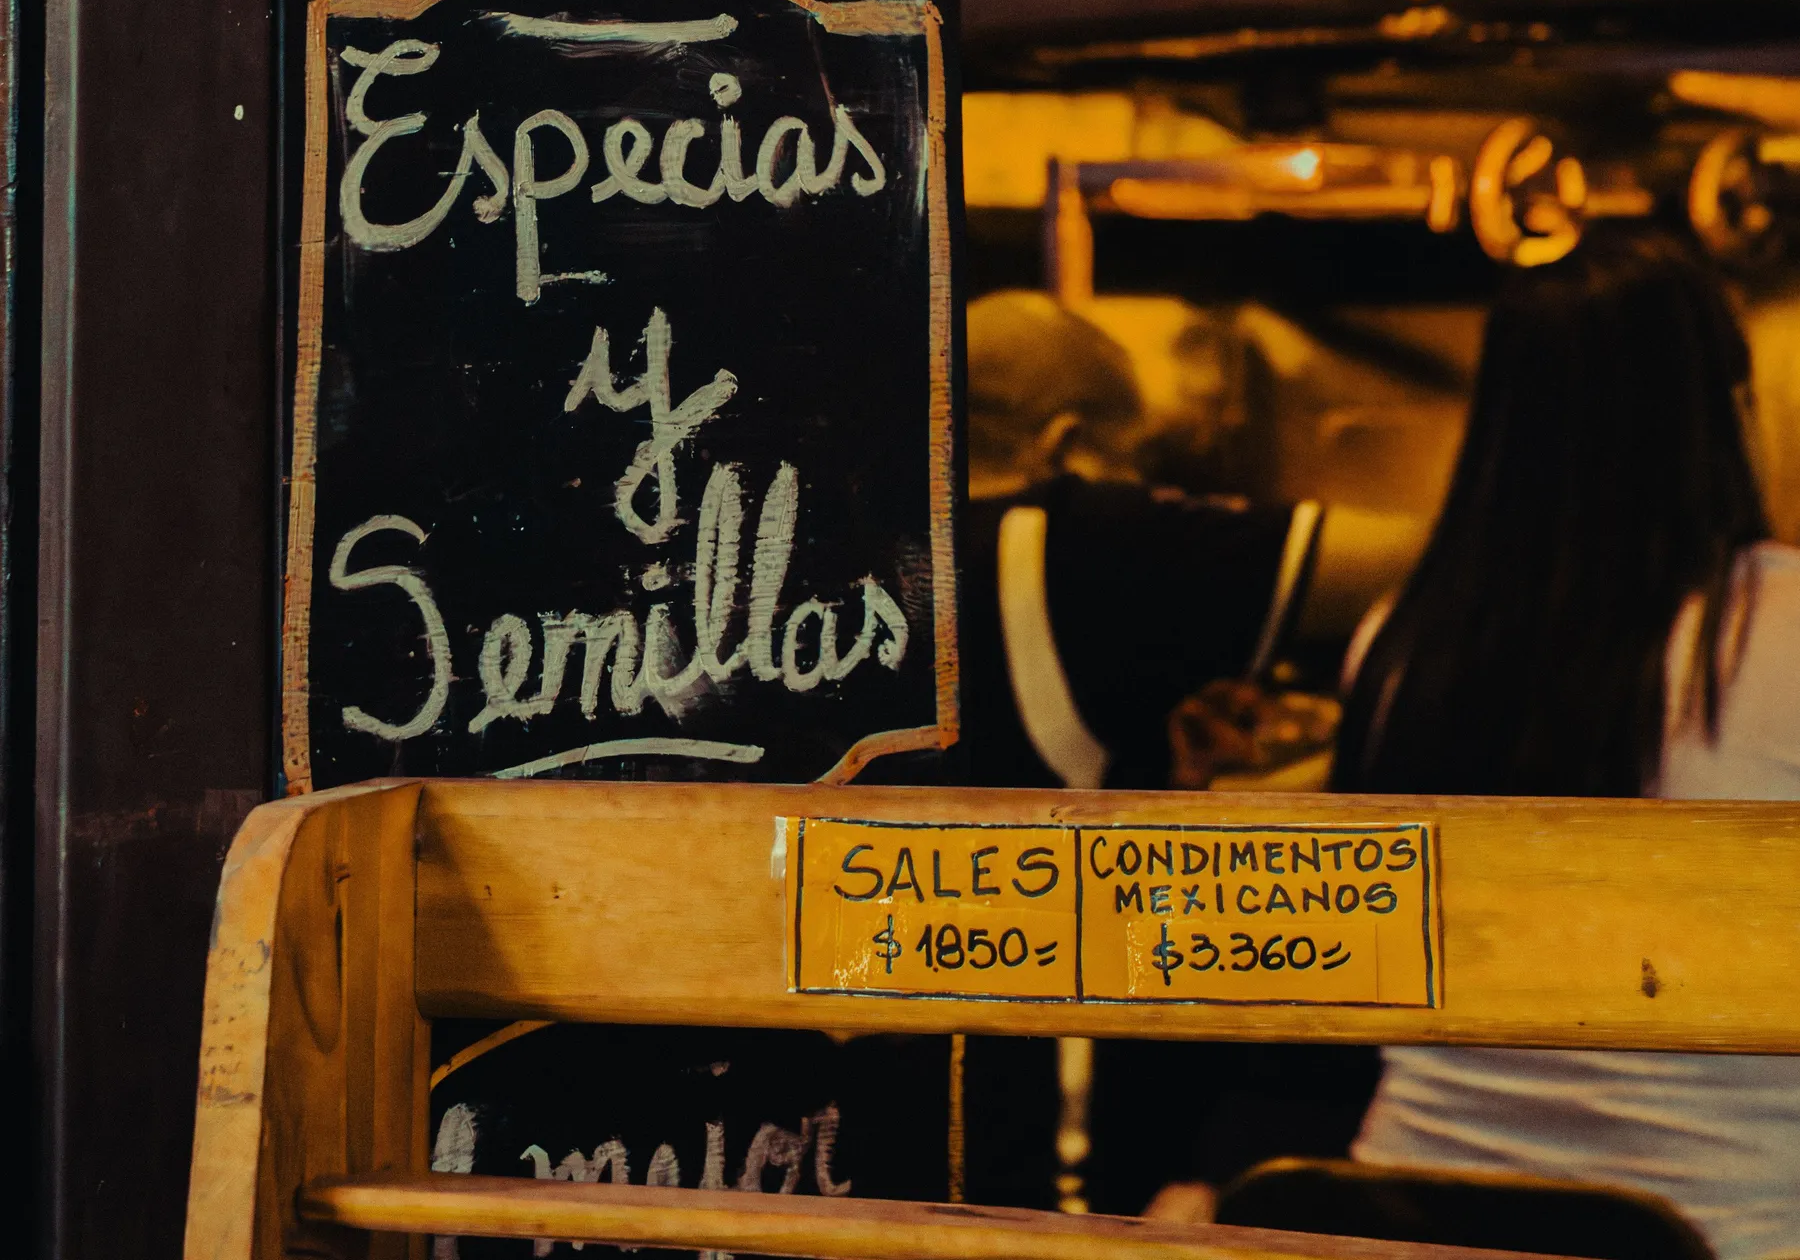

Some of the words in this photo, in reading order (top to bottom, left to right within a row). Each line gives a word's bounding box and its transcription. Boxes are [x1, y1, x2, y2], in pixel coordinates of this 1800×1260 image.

[339, 39, 886, 306] Especias
[564, 306, 739, 544] y
[328, 462, 911, 740] Semillas
[833, 842, 1060, 904] SALES
[1090, 834, 1418, 880] CONDIMENTOS
[1114, 881, 1399, 916] MEXICANOS
